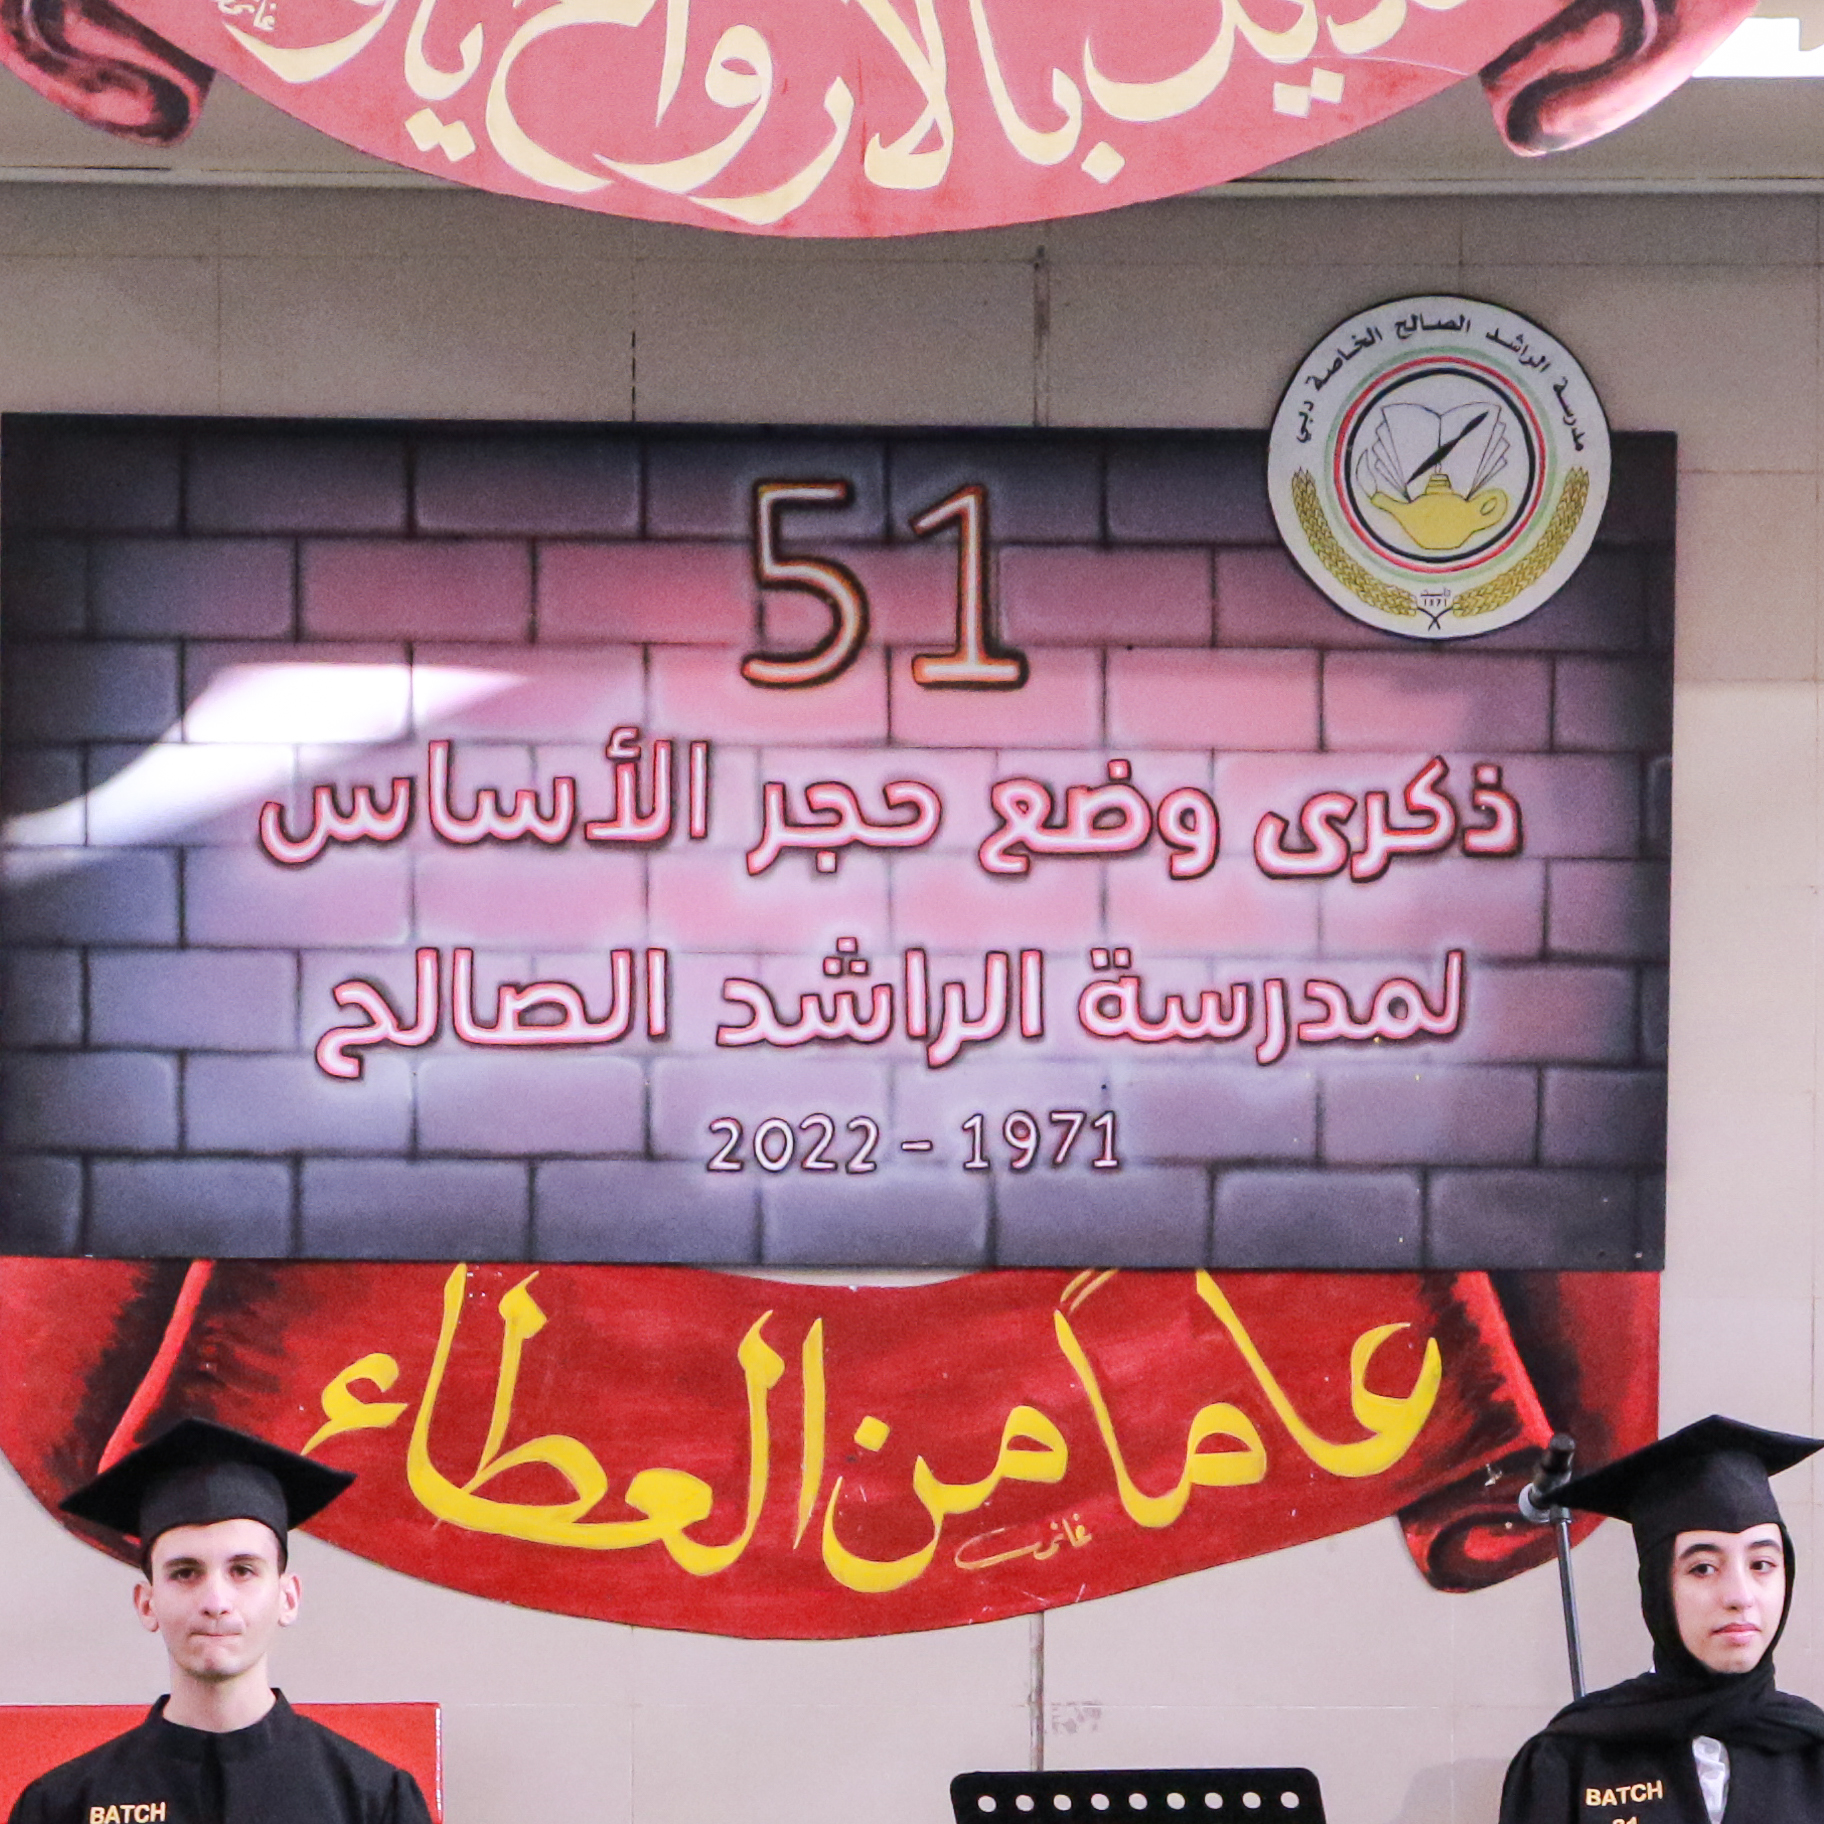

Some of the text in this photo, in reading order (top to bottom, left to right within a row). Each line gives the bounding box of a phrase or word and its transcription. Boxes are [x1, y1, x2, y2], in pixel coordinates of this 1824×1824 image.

[1306, 326, 1383, 392] الخاصة
[1394, 313, 1472, 340] الصالح
[1484, 327, 1551, 373] الراشد
[1551, 375, 1585, 453] مدرسة
[740, 478, 1030, 690] 51
[259, 726, 1523, 884] ذكرى وضع حجر الأساس
[314, 936, 1464, 1080] لمدرسة الراشد الصالح
[706, 1112, 881, 1174] 2022
[961, 1110, 1121, 1170] 1971
[301, 1262, 826, 1577] العطاء
[822, 1405, 1068, 1593] من
[1585, 1779, 1665, 1807] BATCH
